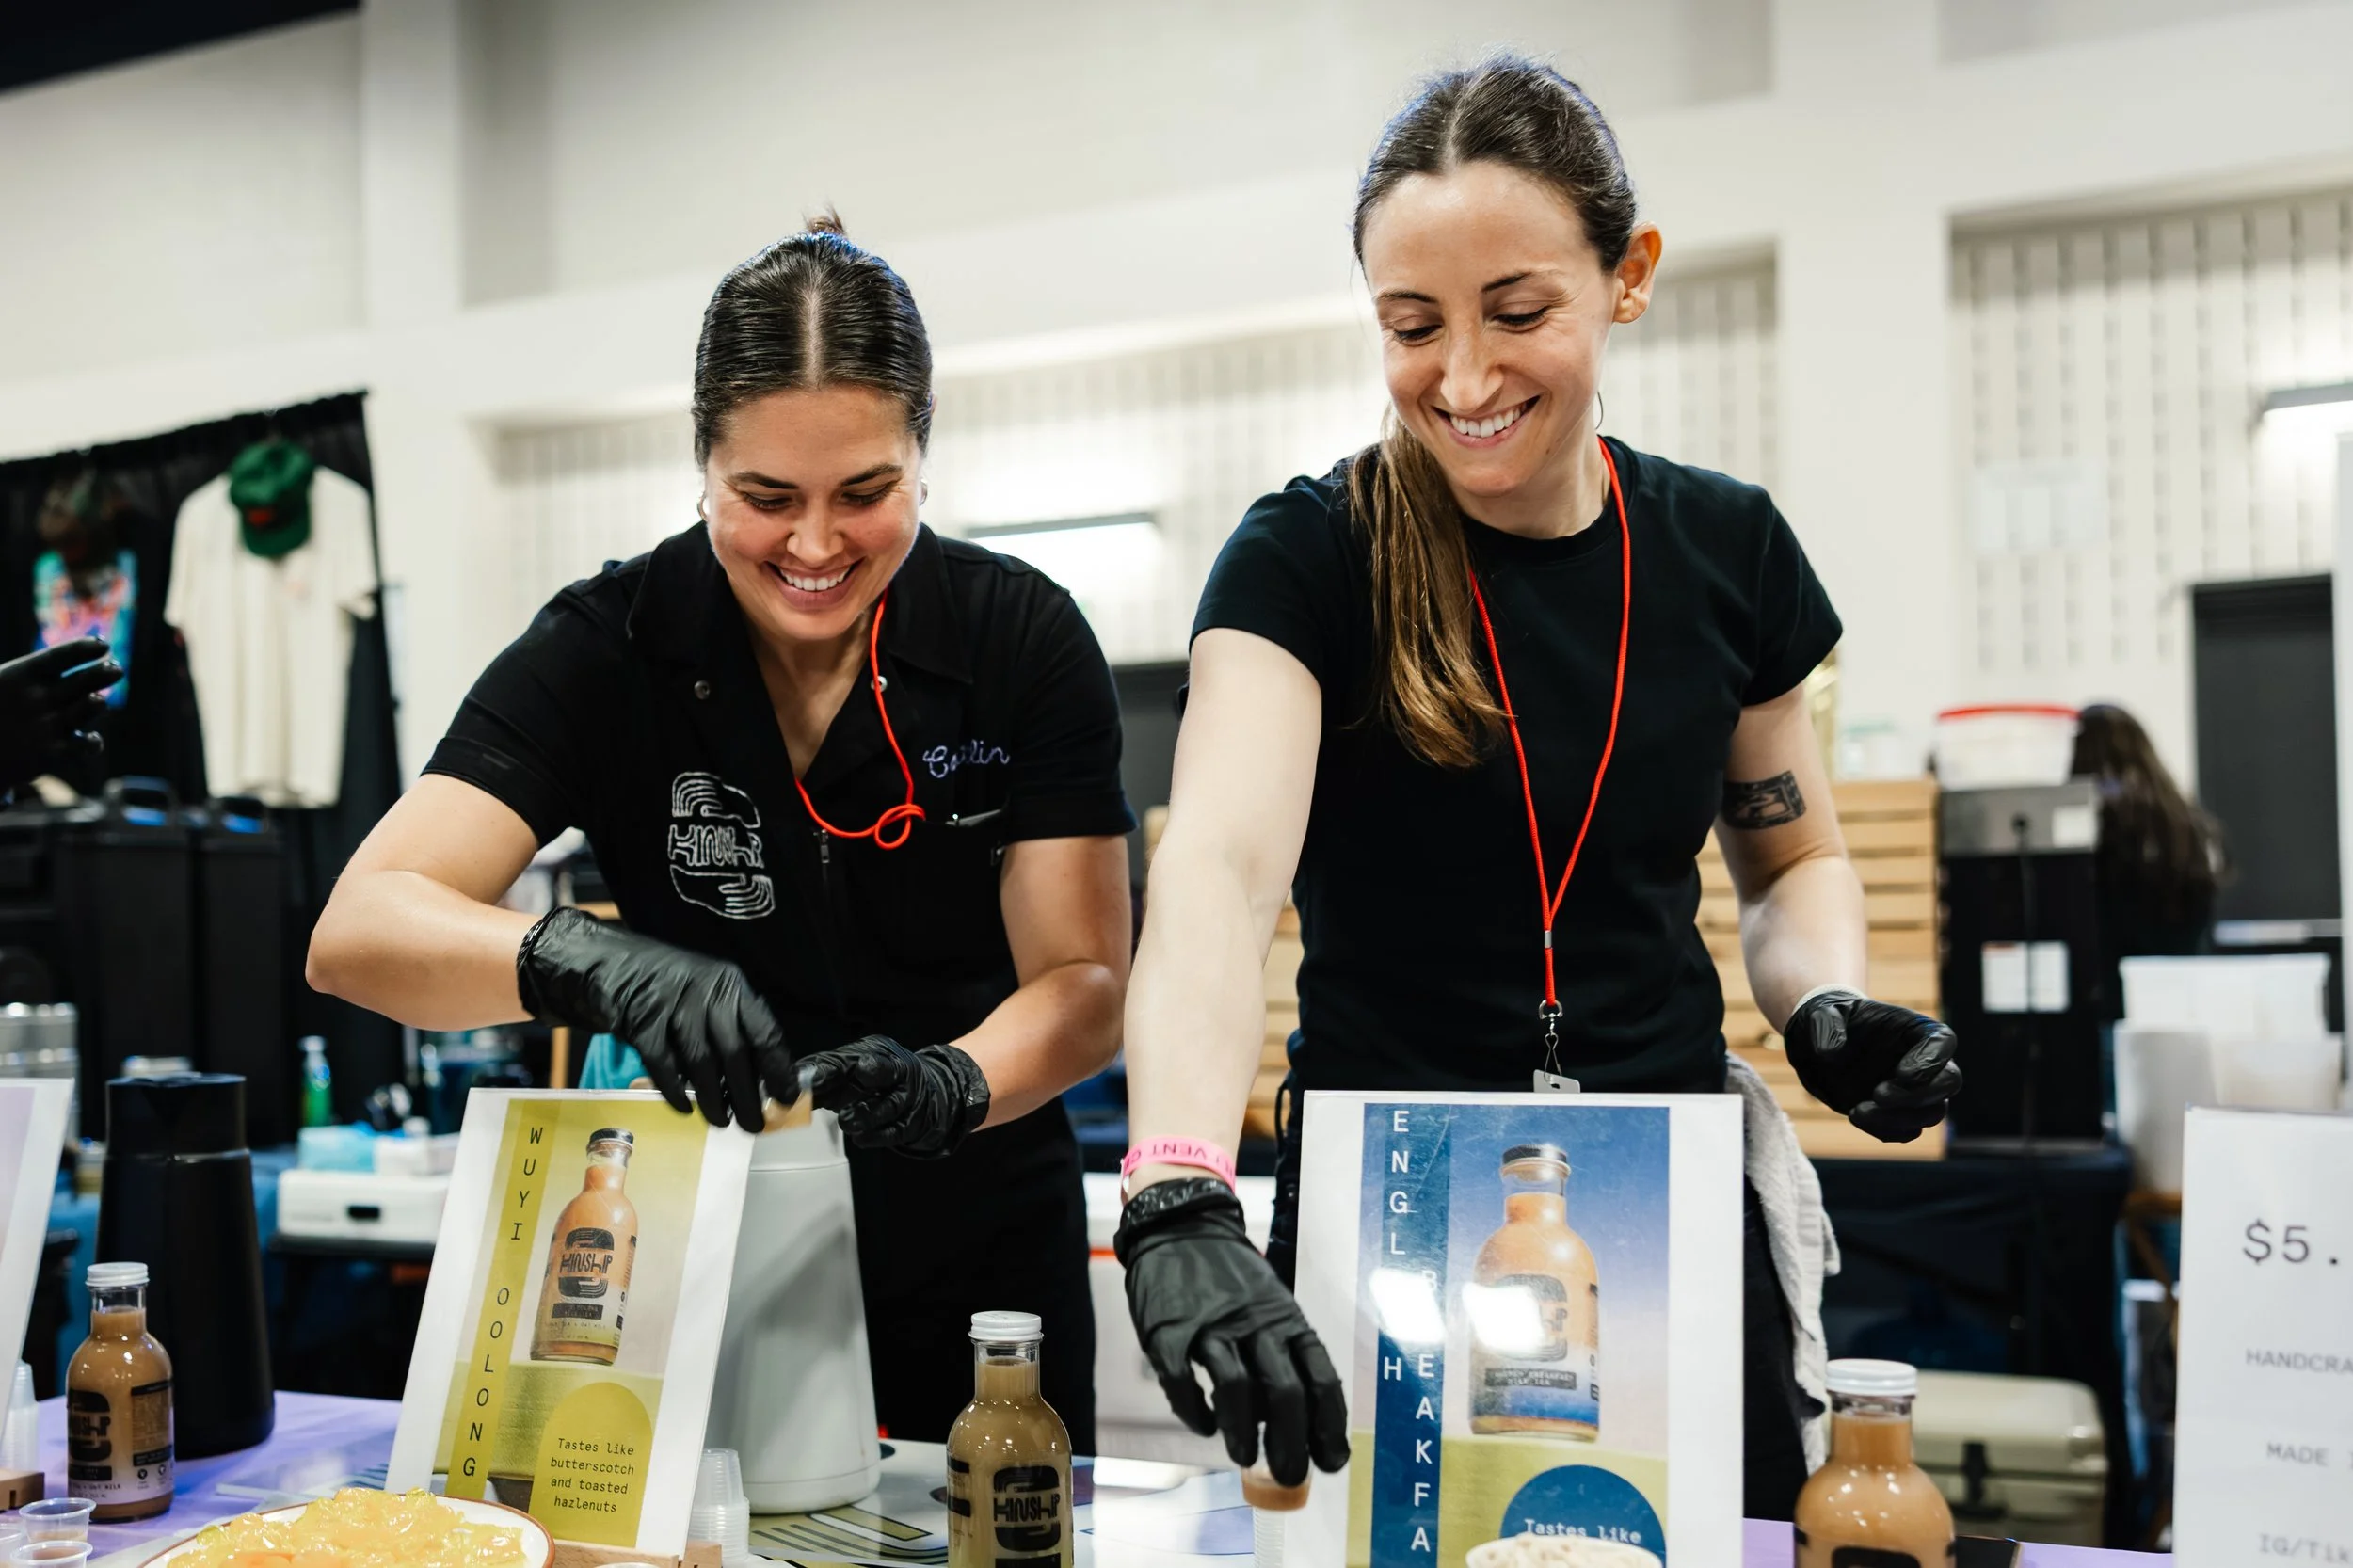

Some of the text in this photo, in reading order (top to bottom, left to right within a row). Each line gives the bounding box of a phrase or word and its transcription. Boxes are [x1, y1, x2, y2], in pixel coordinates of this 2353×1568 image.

[510, 1127, 544, 1241] WUYI
[1382, 1110, 1411, 1381] ENGLH
[462, 1287, 510, 1477] OOLONG
[558, 1437, 635, 1456] Tastes like
[2265, 1441, 2331, 1469] MADE
[550, 1456, 635, 1476] butterscotch
[551, 1477, 629, 1495] and toasted
[553, 1495, 617, 1513] hazlenuts
[1523, 1517, 1642, 1544] Tastes like
